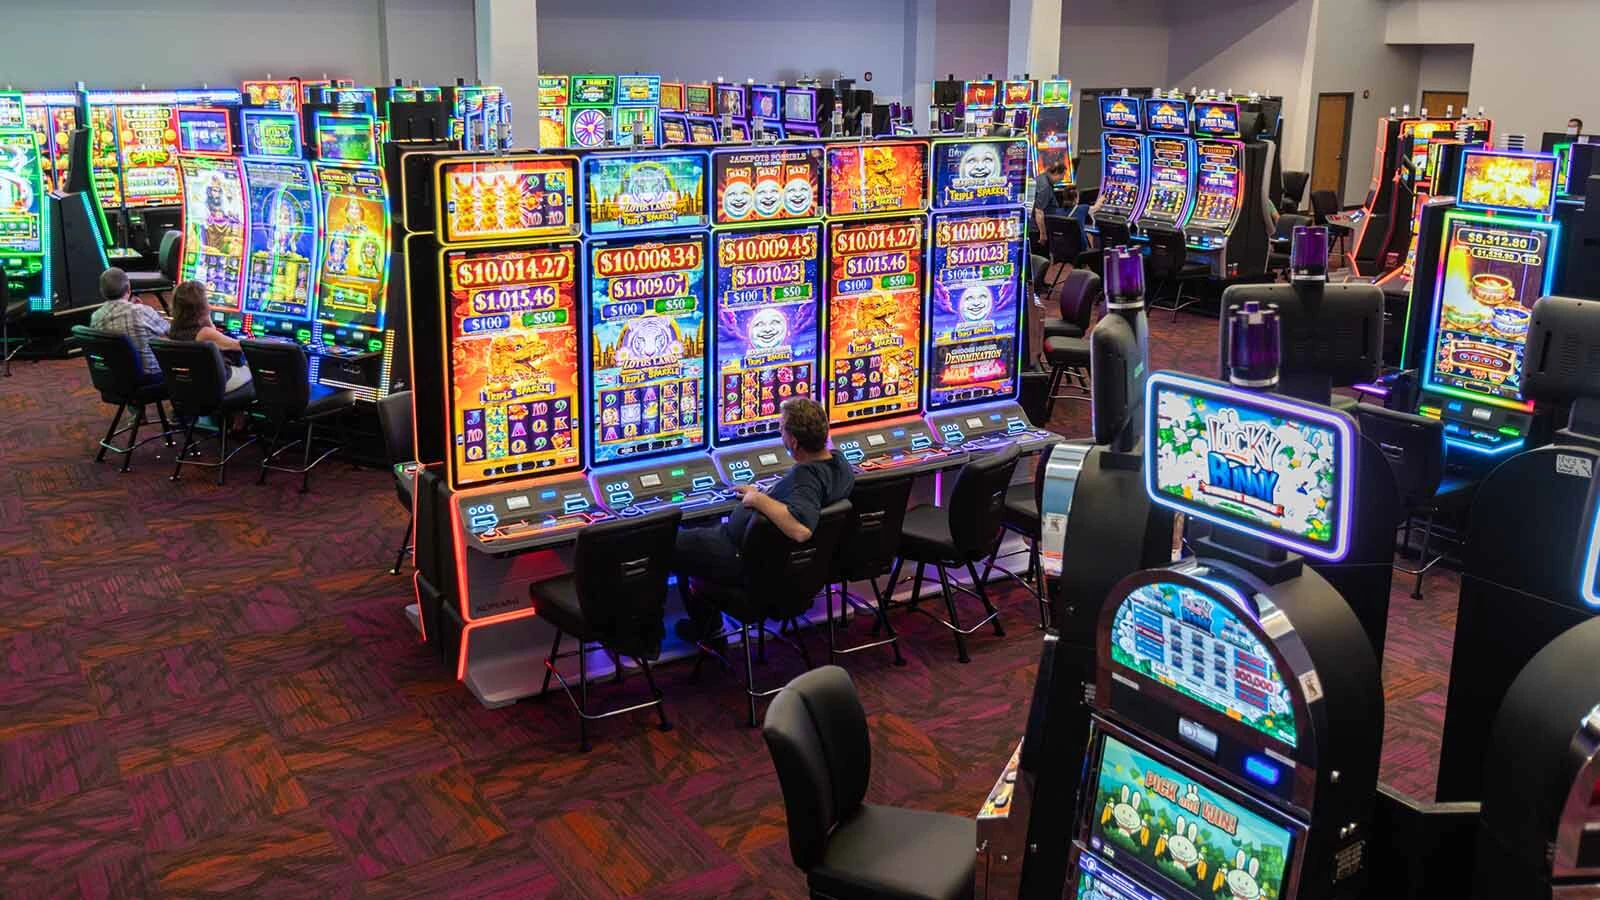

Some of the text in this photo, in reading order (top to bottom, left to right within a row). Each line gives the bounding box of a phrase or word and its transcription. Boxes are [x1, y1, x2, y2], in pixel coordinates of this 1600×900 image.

[729, 154, 769, 164] JACKPOTS
[771, 152, 806, 162] POSSIBLE
[949, 186, 1008, 201] TRIPLE SPARKLE
[623, 211, 676, 225] TRIPLE SPARKLE
[942, 218, 1016, 242] $10,009.45
[837, 227, 916, 252] $10,014.27
[1467, 232, 1527, 249] $8,312.80
[725, 236, 811, 262] $10,009.45
[950, 245, 1004, 264] $1,010.23
[600, 246, 697, 273] $10,008.34
[847, 254, 907, 275] $1,015.46
[459, 256, 566, 284] $10,014.27
[737, 264, 801, 286] $1,010.23
[947, 265, 1005, 280] $100 $50
[844, 275, 906, 291] $100 $50
[475, 288, 555, 311] $1,015.46
[733, 285, 801, 303] $100 $50
[611, 299, 685, 317] $100 $50
[472, 311, 556, 331] $100 $50
[853, 343, 872, 353] TRIPLE
[944, 349, 1003, 365] DENOMINATION
[624, 355, 679, 370] LOTUS LAND
[622, 368, 679, 384] TRIPLE SPARKLE
[487, 384, 550, 402] TRIPLE SPARKLE
[1208, 416, 1281, 471] LUCKY
[1144, 770, 1239, 836] PICK and WIN!
